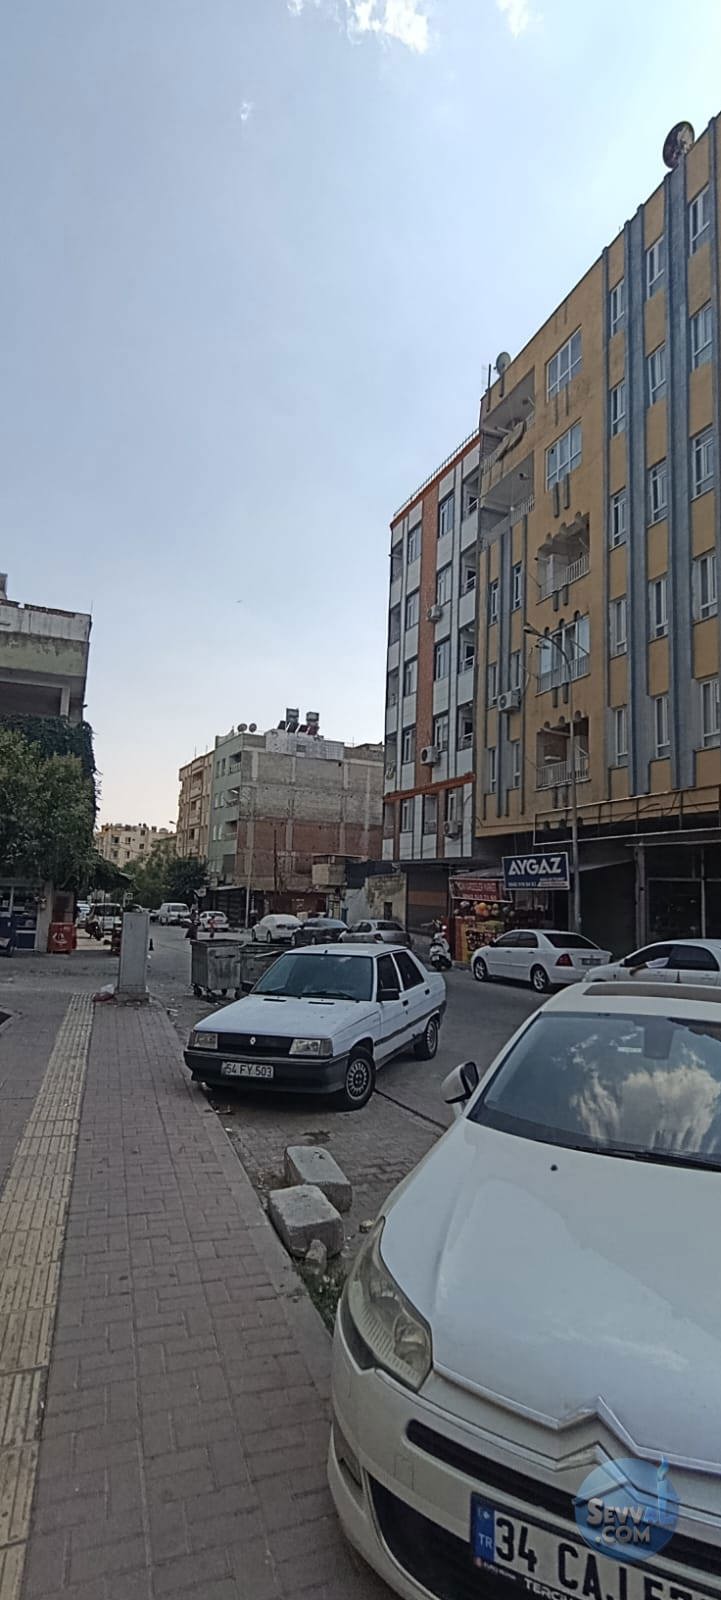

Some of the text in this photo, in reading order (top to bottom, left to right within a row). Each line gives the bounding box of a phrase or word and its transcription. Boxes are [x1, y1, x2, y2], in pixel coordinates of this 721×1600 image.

[508, 857, 562, 875] AYGAZ
[239, 1064, 253, 1075] FY
[255, 1065, 272, 1077] 503
[478, 1532, 493, 1549] TR
[496, 1518, 537, 1572] 34
